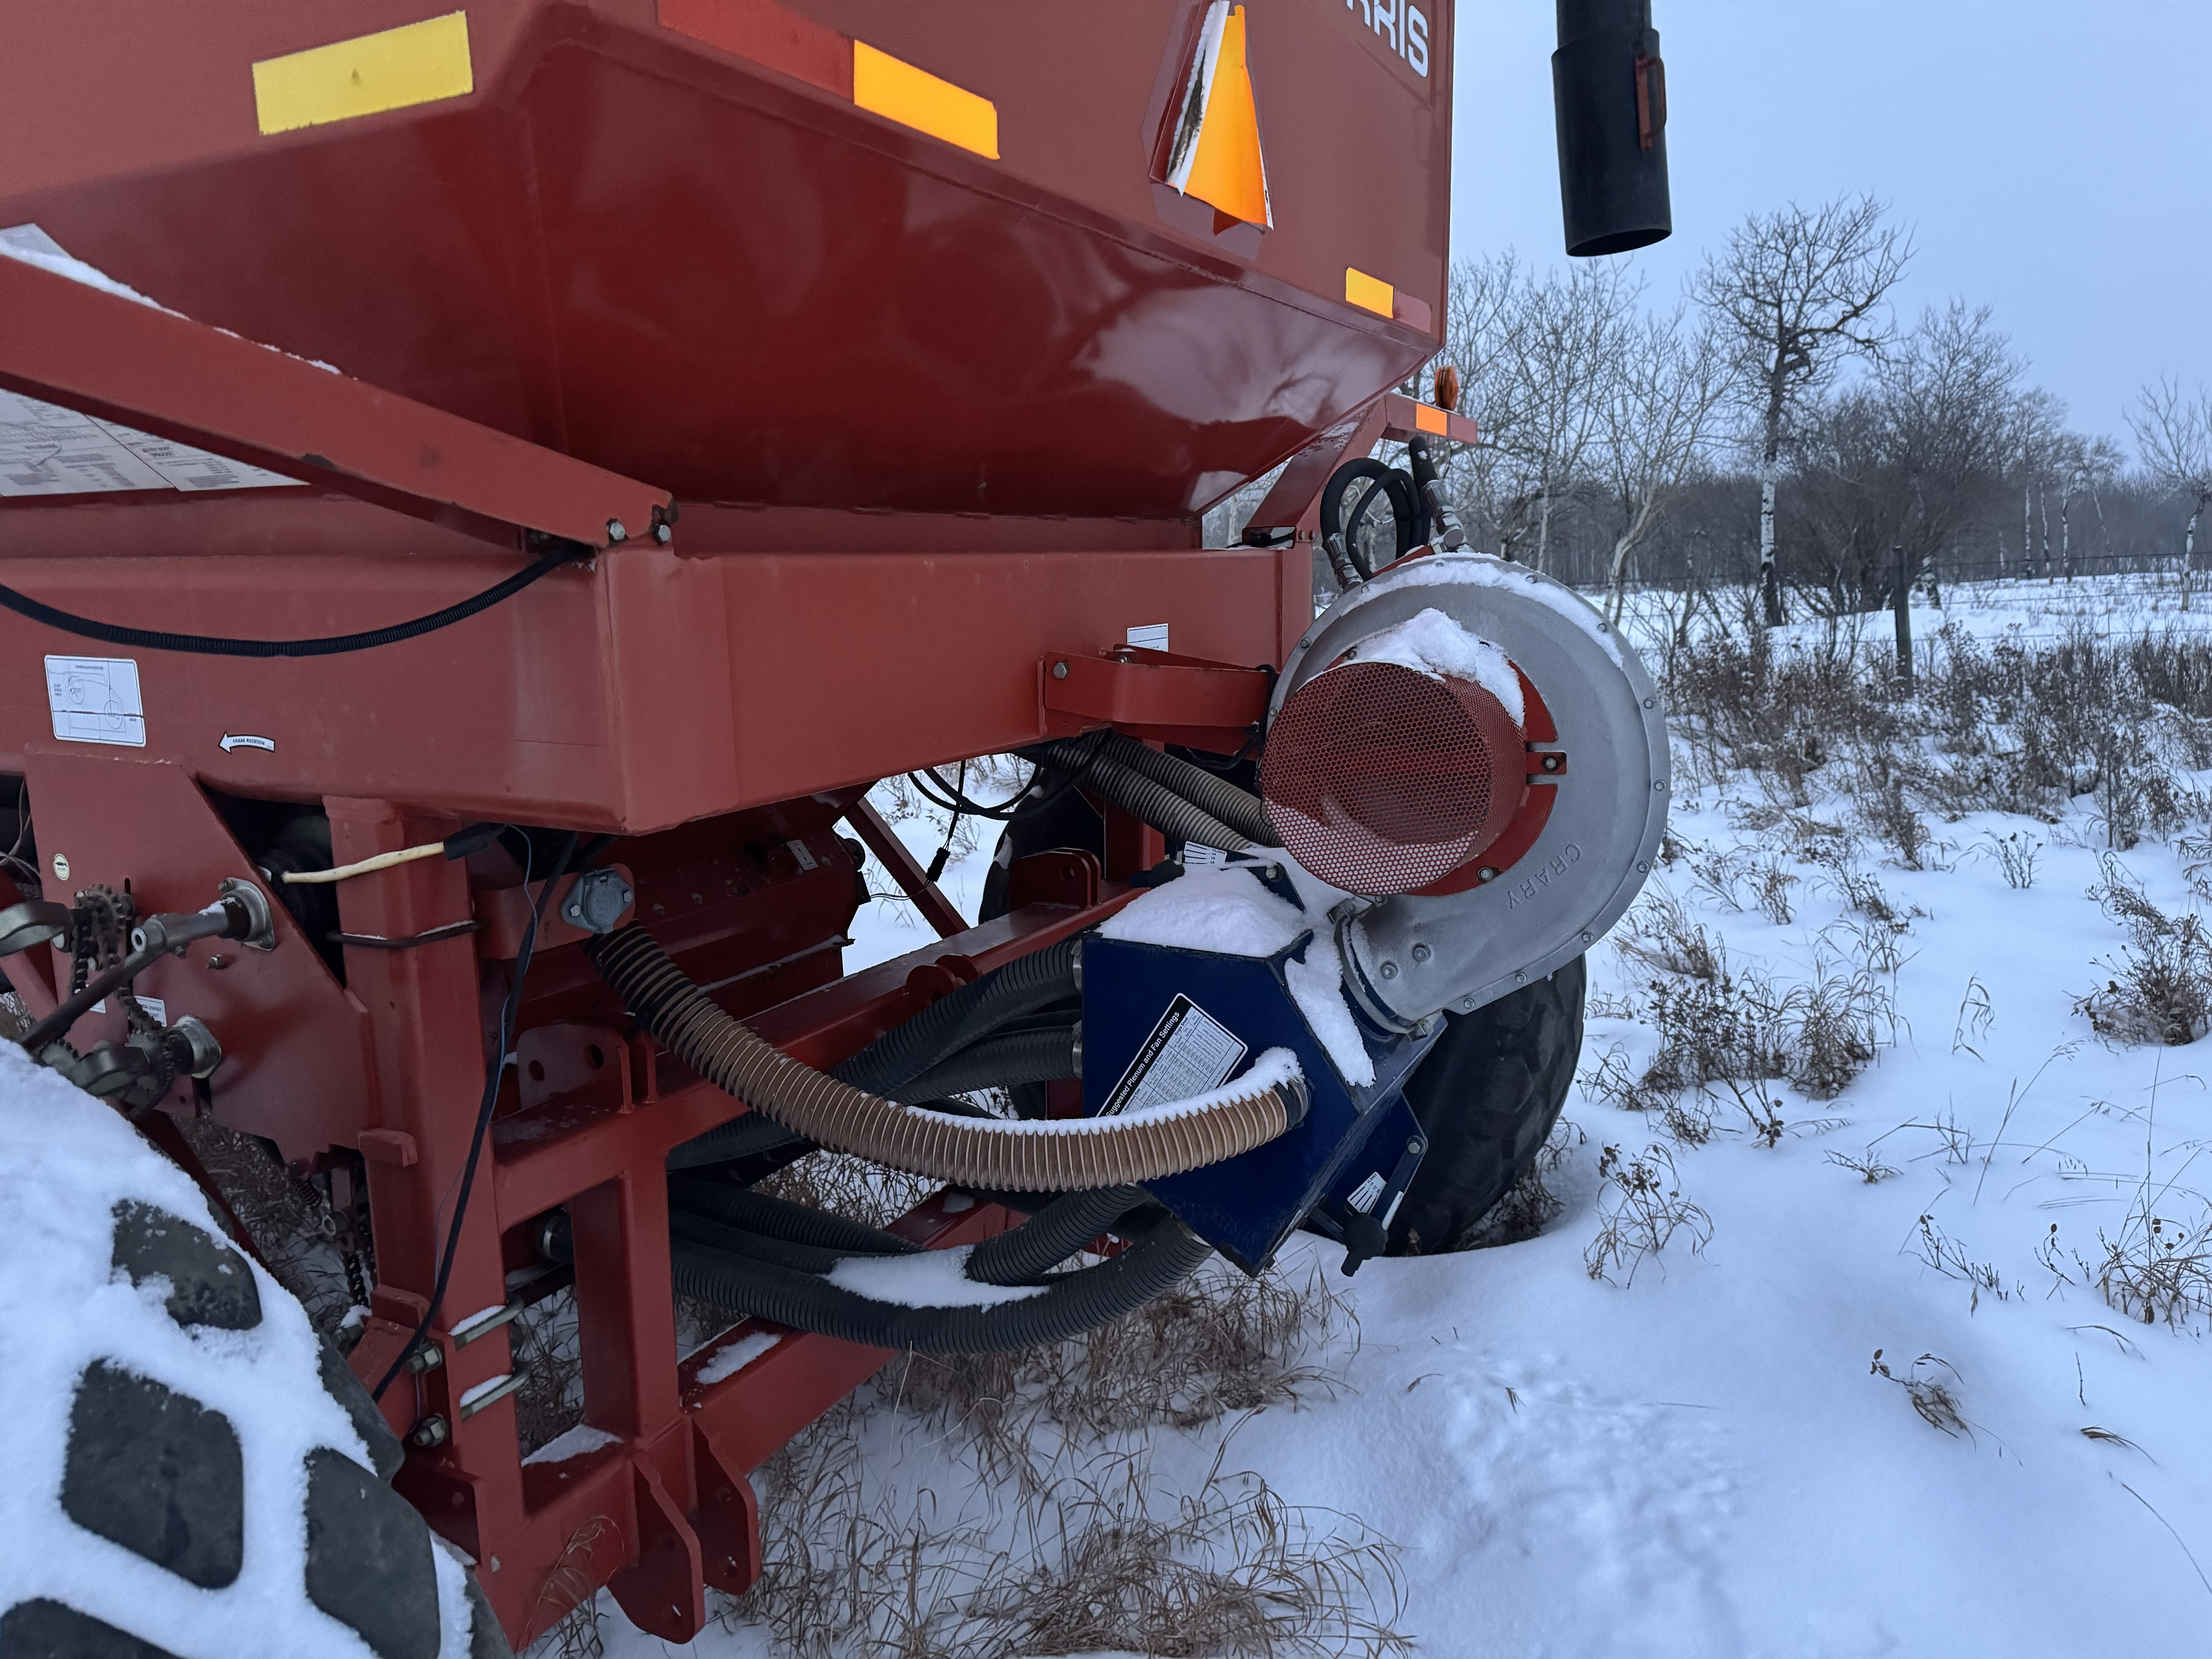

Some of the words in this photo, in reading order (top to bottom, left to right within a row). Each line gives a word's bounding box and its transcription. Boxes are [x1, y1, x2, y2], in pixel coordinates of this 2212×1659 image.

[1507, 843, 1582, 909] CRARY
[1174, 1025, 1183, 1036] Single
[1106, 1085, 1129, 1116] Suggested
[1127, 1063, 1145, 1086] Plenum
[1144, 1049, 1153, 1063] and
[1151, 1038, 1162, 1051] Fan
[1159, 1012, 1179, 1038] Settings
[1149, 1062, 1158, 1073] Double
